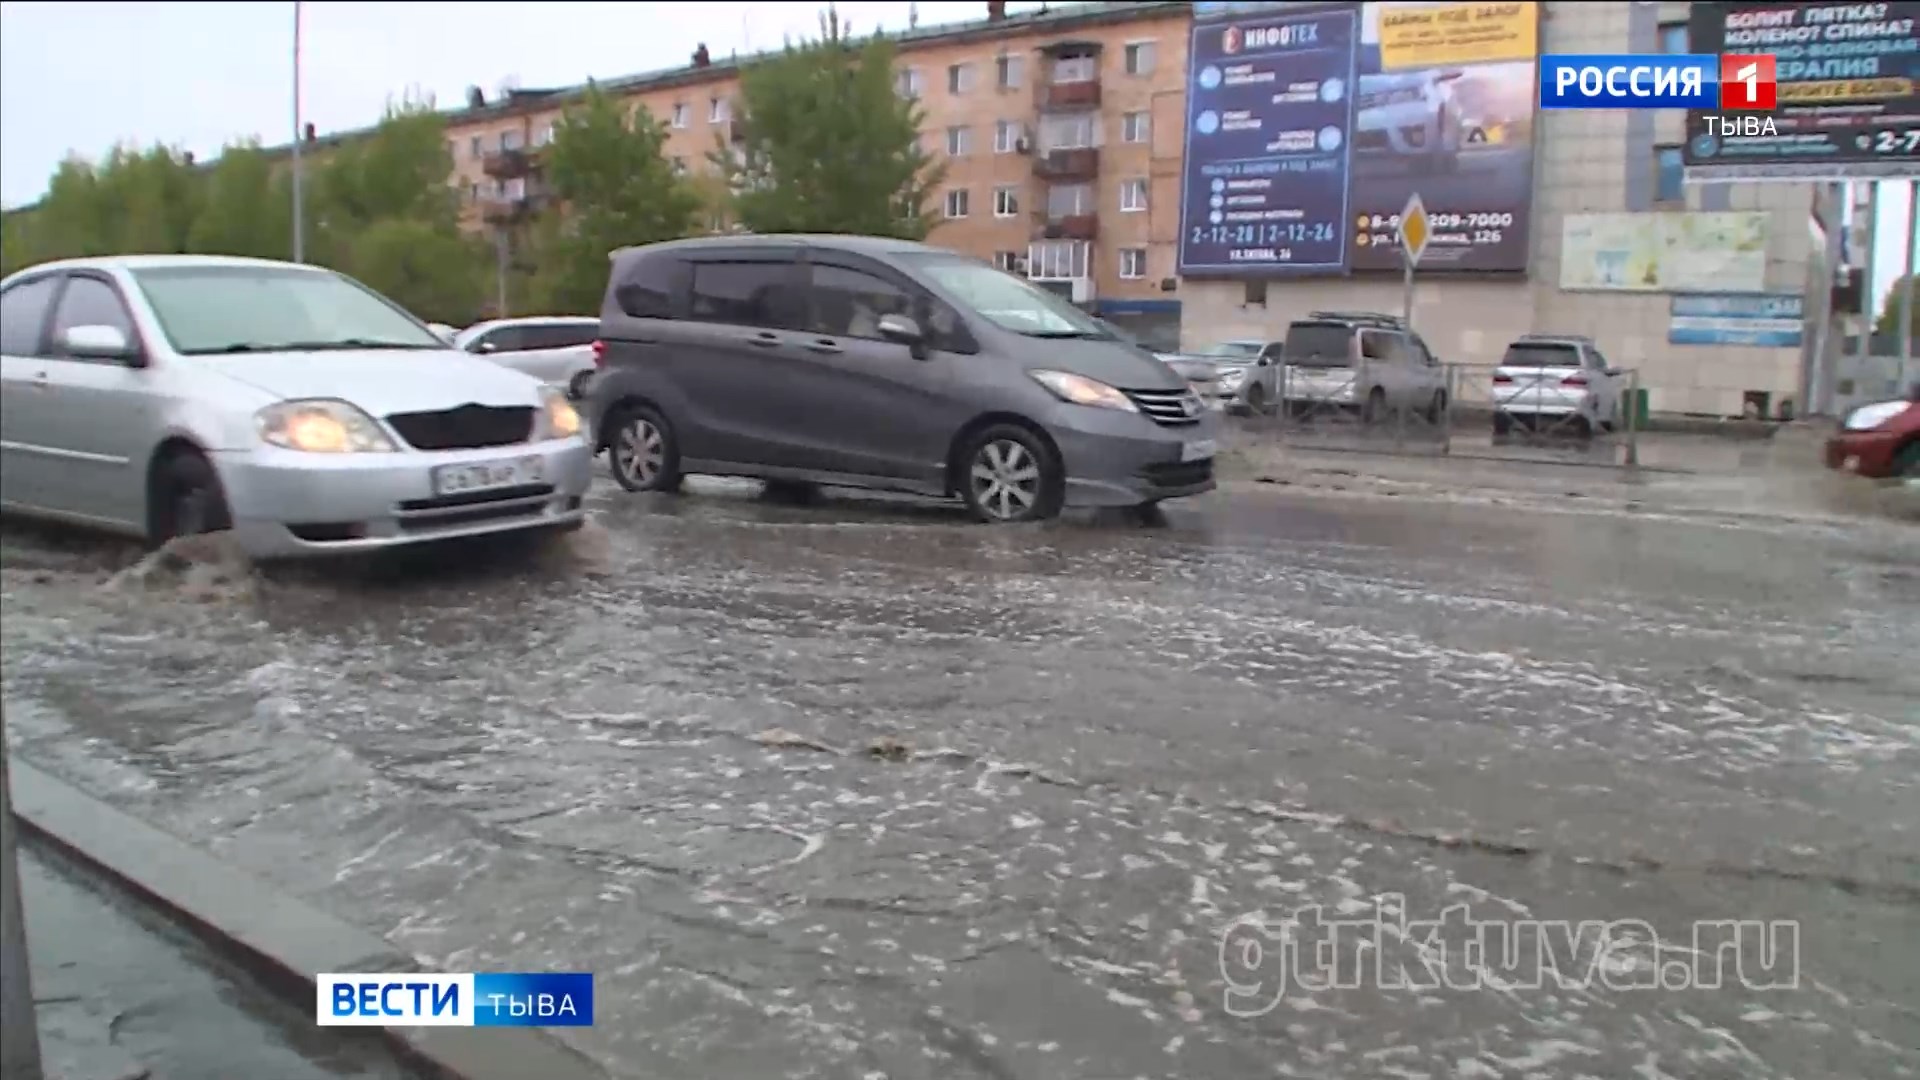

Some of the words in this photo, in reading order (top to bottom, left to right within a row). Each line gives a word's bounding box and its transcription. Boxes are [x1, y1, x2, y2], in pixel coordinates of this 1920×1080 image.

[1725, 10, 1796, 29] БОЛИТ
[1805, 3, 1889, 24] ПЯТКА?
[1245, 22, 1318, 48] ИНФОТЕХ
[1724, 26, 1821, 45] КОЛЕНО?
[1826, 19, 1914, 40] СПИНА?
[1777, 57, 1879, 78] ЕРАПИЯ
